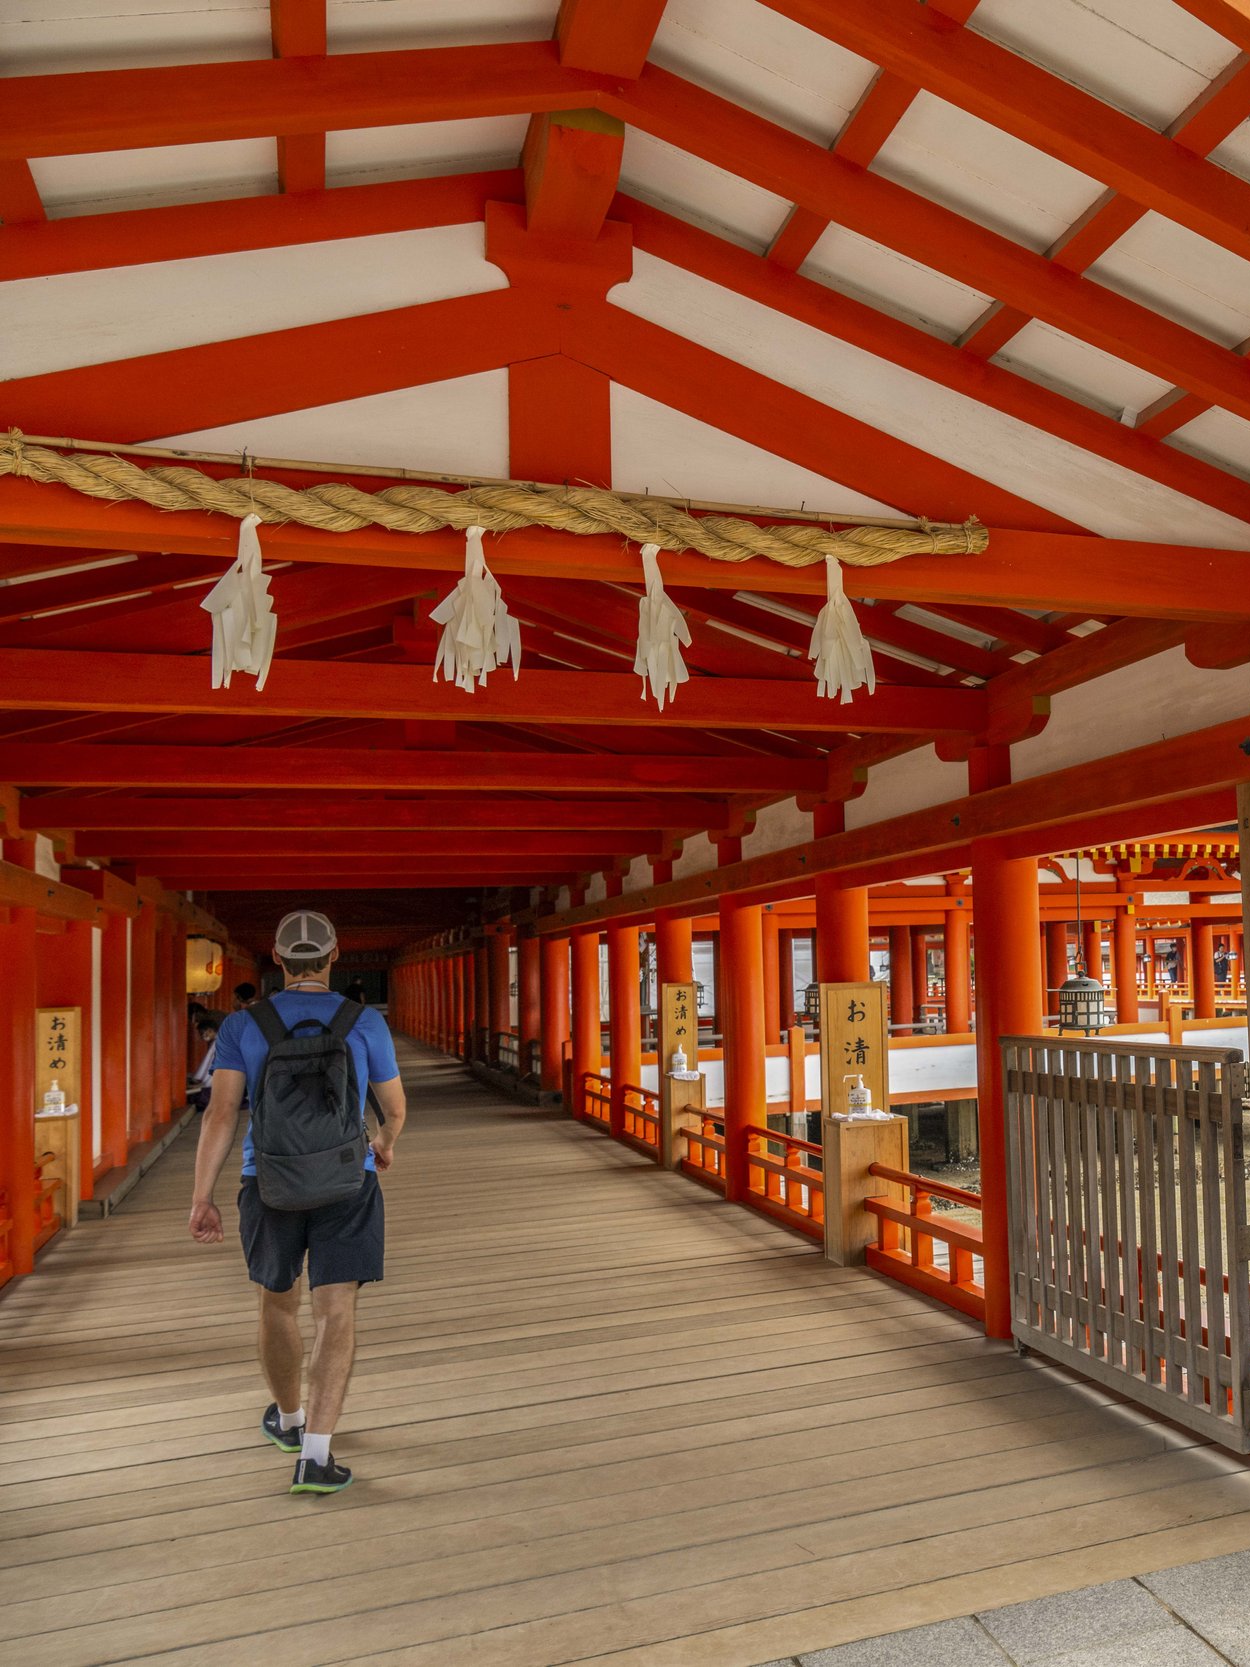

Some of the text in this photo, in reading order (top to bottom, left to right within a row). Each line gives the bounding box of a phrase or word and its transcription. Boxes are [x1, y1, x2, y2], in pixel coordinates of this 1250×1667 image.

[674, 989, 688, 1036] お清め
[47, 1016, 68, 1069] お清め
[844, 999, 870, 1097] お清
